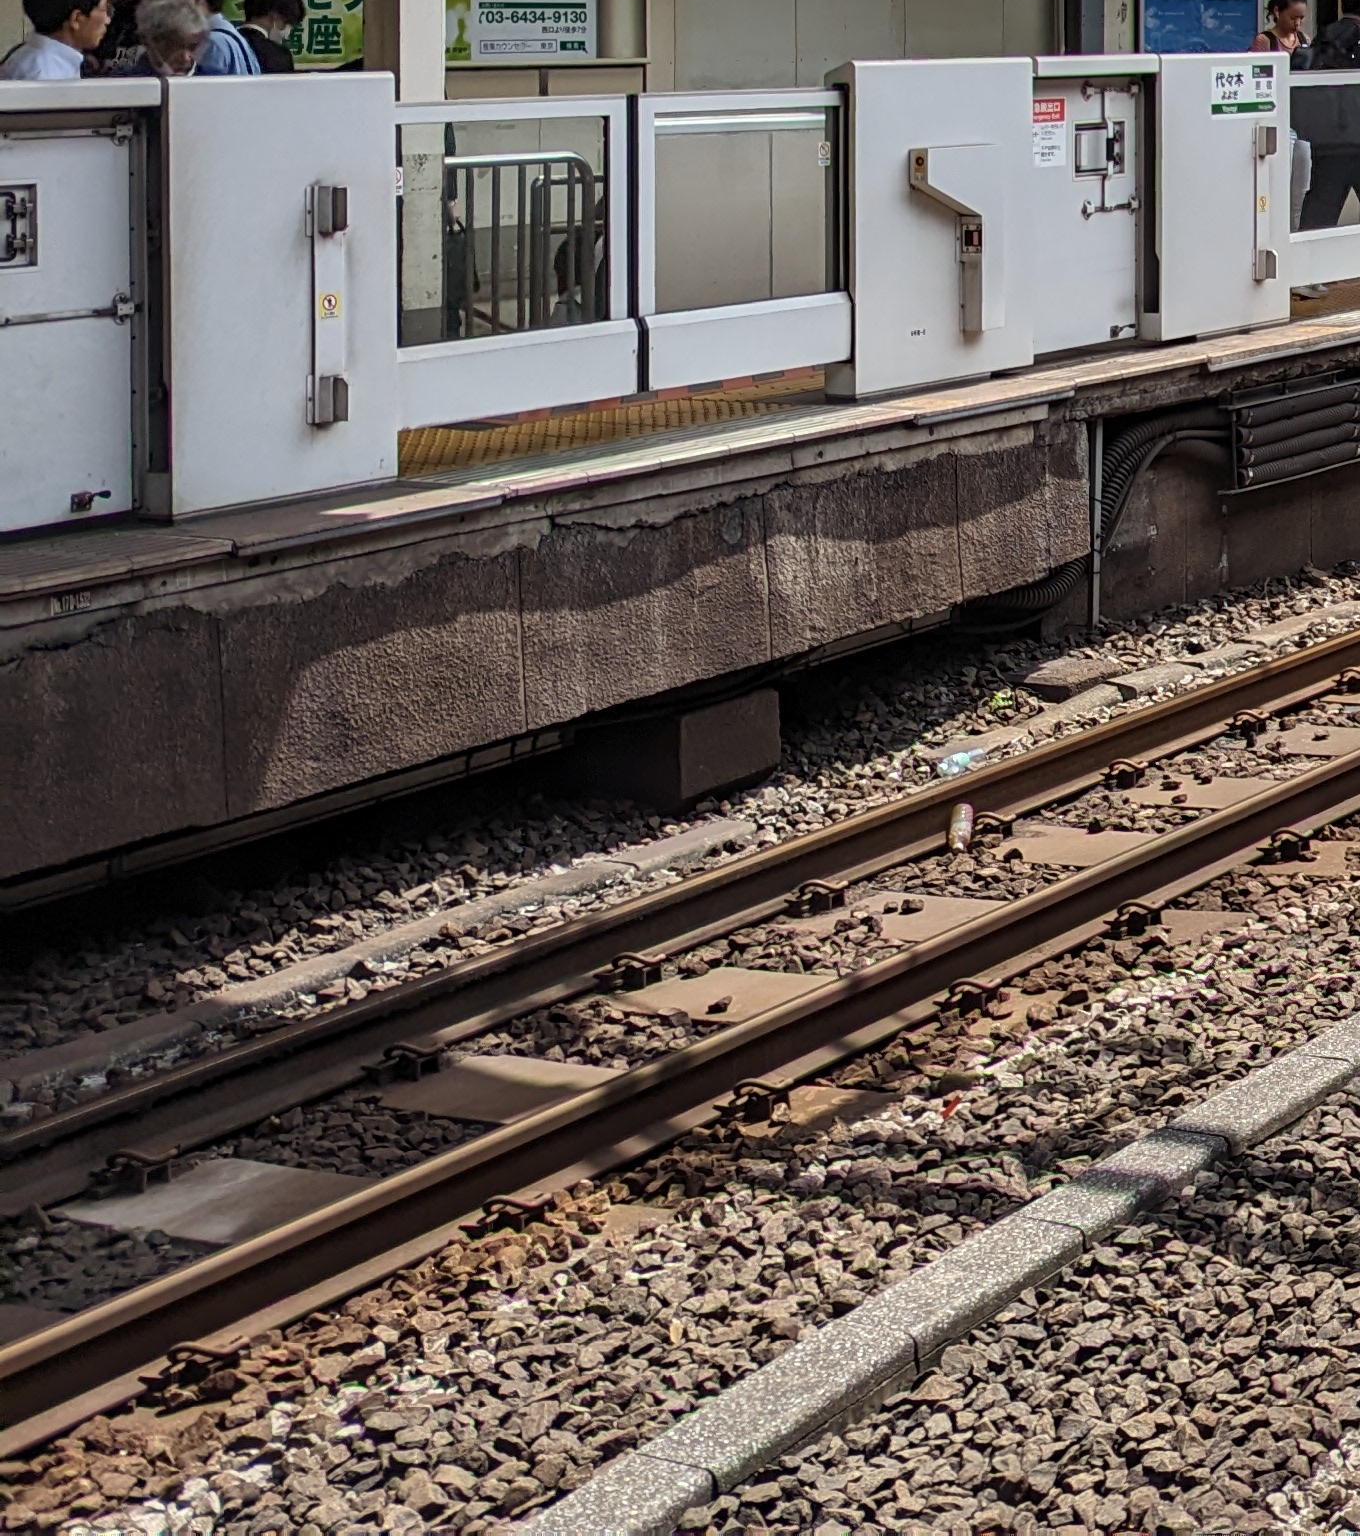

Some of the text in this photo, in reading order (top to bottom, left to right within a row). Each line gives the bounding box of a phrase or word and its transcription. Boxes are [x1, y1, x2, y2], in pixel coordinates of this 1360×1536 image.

[485, 10, 588, 25] 03-6434-9130
[540, 41, 554, 51] 東京
[1216, 71, 1244, 89] 代々木
[1221, 90, 1239, 100] よよぎ
